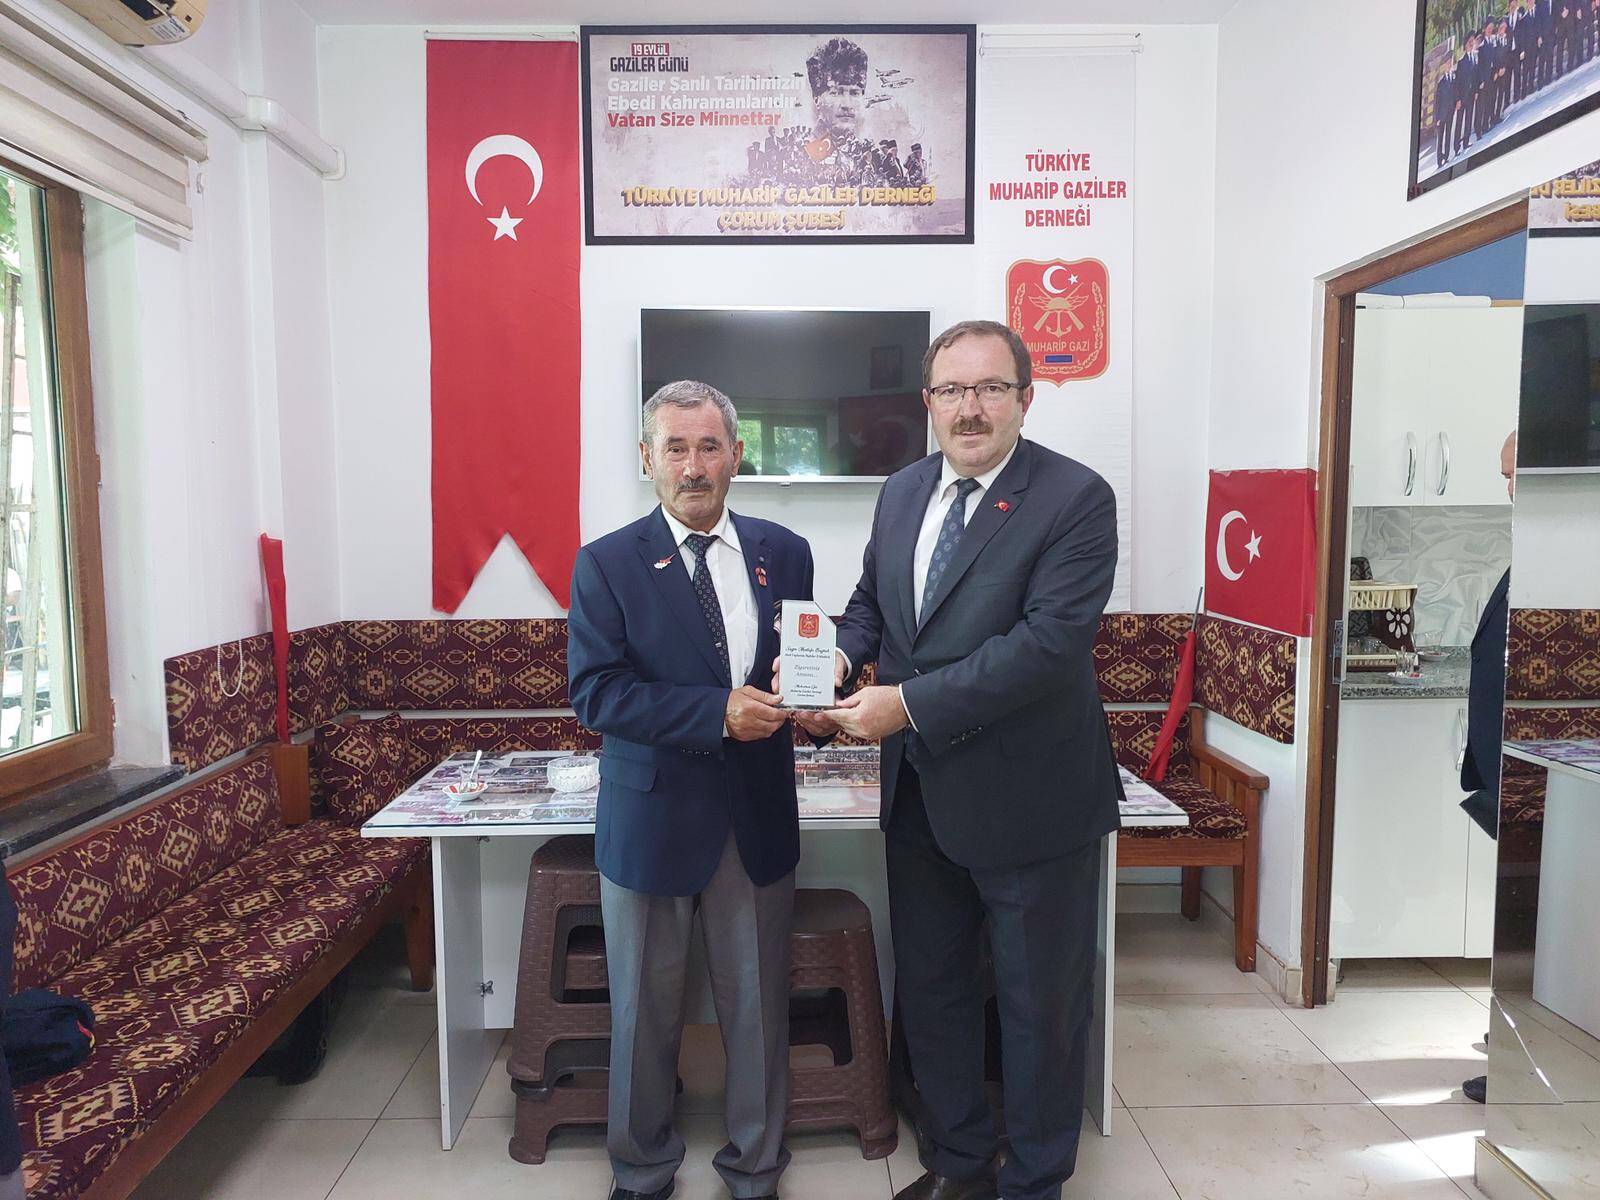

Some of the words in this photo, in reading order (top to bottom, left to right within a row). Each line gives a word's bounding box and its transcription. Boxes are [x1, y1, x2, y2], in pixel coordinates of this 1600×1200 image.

[633, 43, 643, 56] 19
[644, 43, 668, 56] EYLÜL
[610, 57, 655, 72] GAZİLER
[658, 57, 689, 72] GÜNÜ
[607, 76, 665, 92] Gaziler
[670, 75, 710, 94] Şanlı
[607, 95, 656, 111] Ebedi
[607, 112, 656, 128] Vatan
[660, 112, 695, 127] Size
[700, 111, 781, 126] Minnettar
[1025, 149, 1090, 172] TÜRKİYE
[622, 185, 697, 207] TÜRKİYE
[700, 185, 781, 207] MUHARİP
[784, 183, 858, 206] GAZİLER
[859, 184, 937, 206] DERNEĞİ
[989, 177, 1059, 201] MUHARİP
[1063, 176, 1127, 199] GAZİLER
[717, 210, 781, 233] ÇORUM
[783, 209, 846, 233] ŞUBESİ
[1025, 204, 1091, 227] DERNEĞİ
[1026, 340, 1067, 352] MUHARİP
